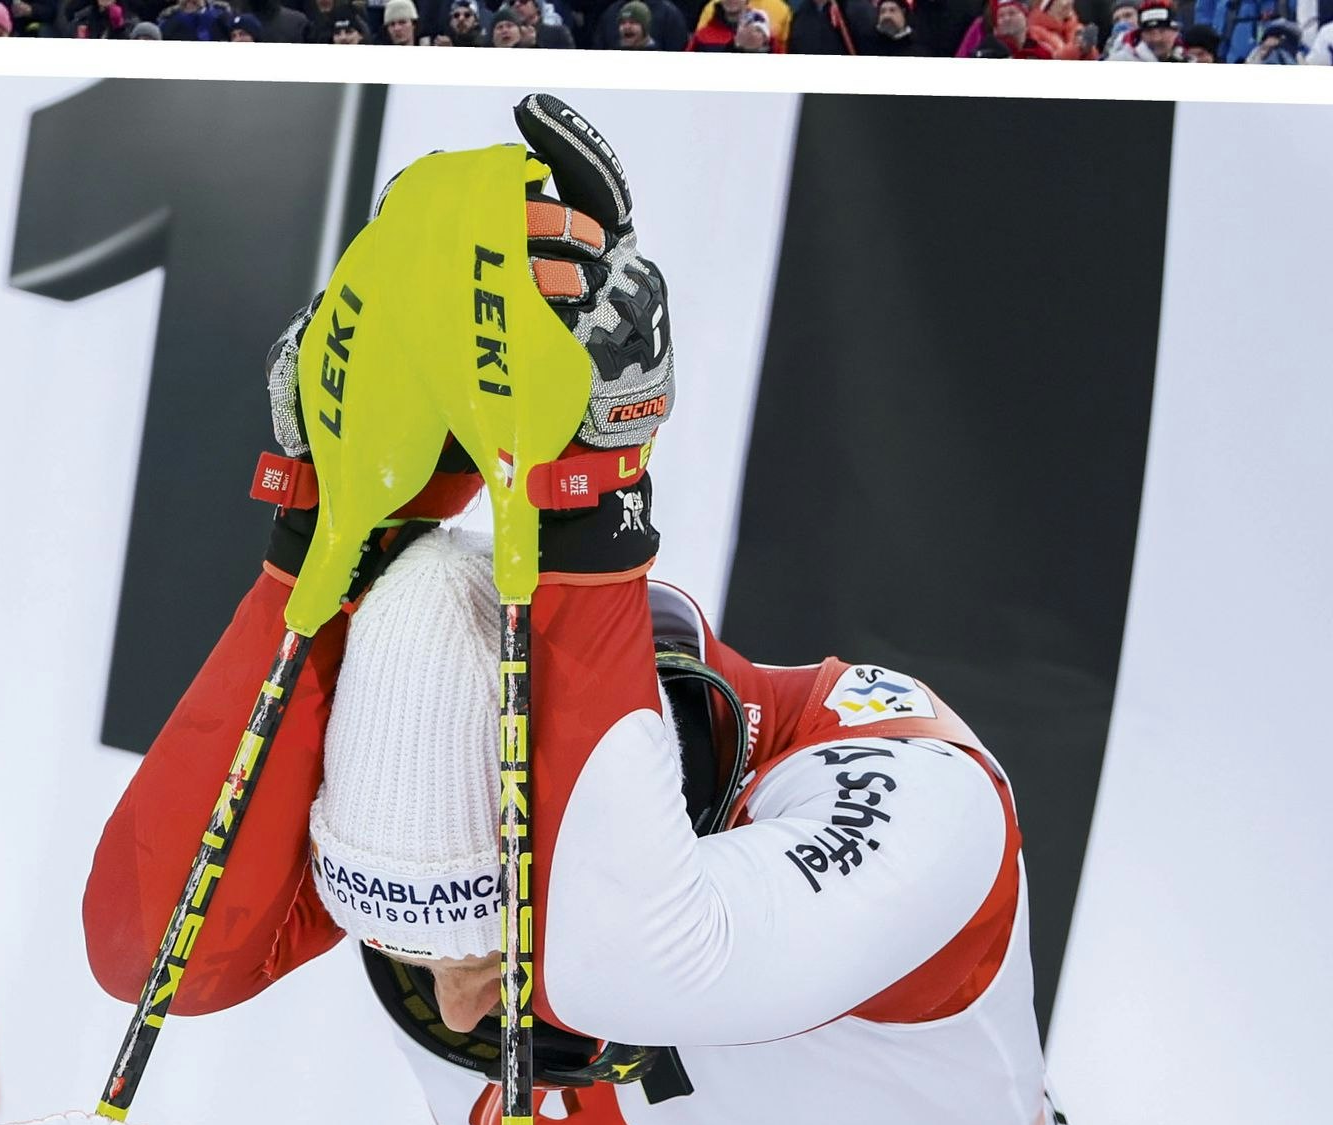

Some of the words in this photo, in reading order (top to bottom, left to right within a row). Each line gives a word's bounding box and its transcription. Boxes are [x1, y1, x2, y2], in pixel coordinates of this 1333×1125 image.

[474, 244, 513, 398] LEKI
[319, 284, 364, 439] LEKI
[609, 395, 667, 422] racing
[261, 467, 275, 489] ONE
[270, 469, 284, 491] SIZE
[569, 475, 579, 496] SIZE
[578, 474, 588, 495] ONE
[500, 660, 528, 838] LEKI
[322, 855, 502, 905] CASABLANC
[326, 875, 502, 924] hotelsoftwar
